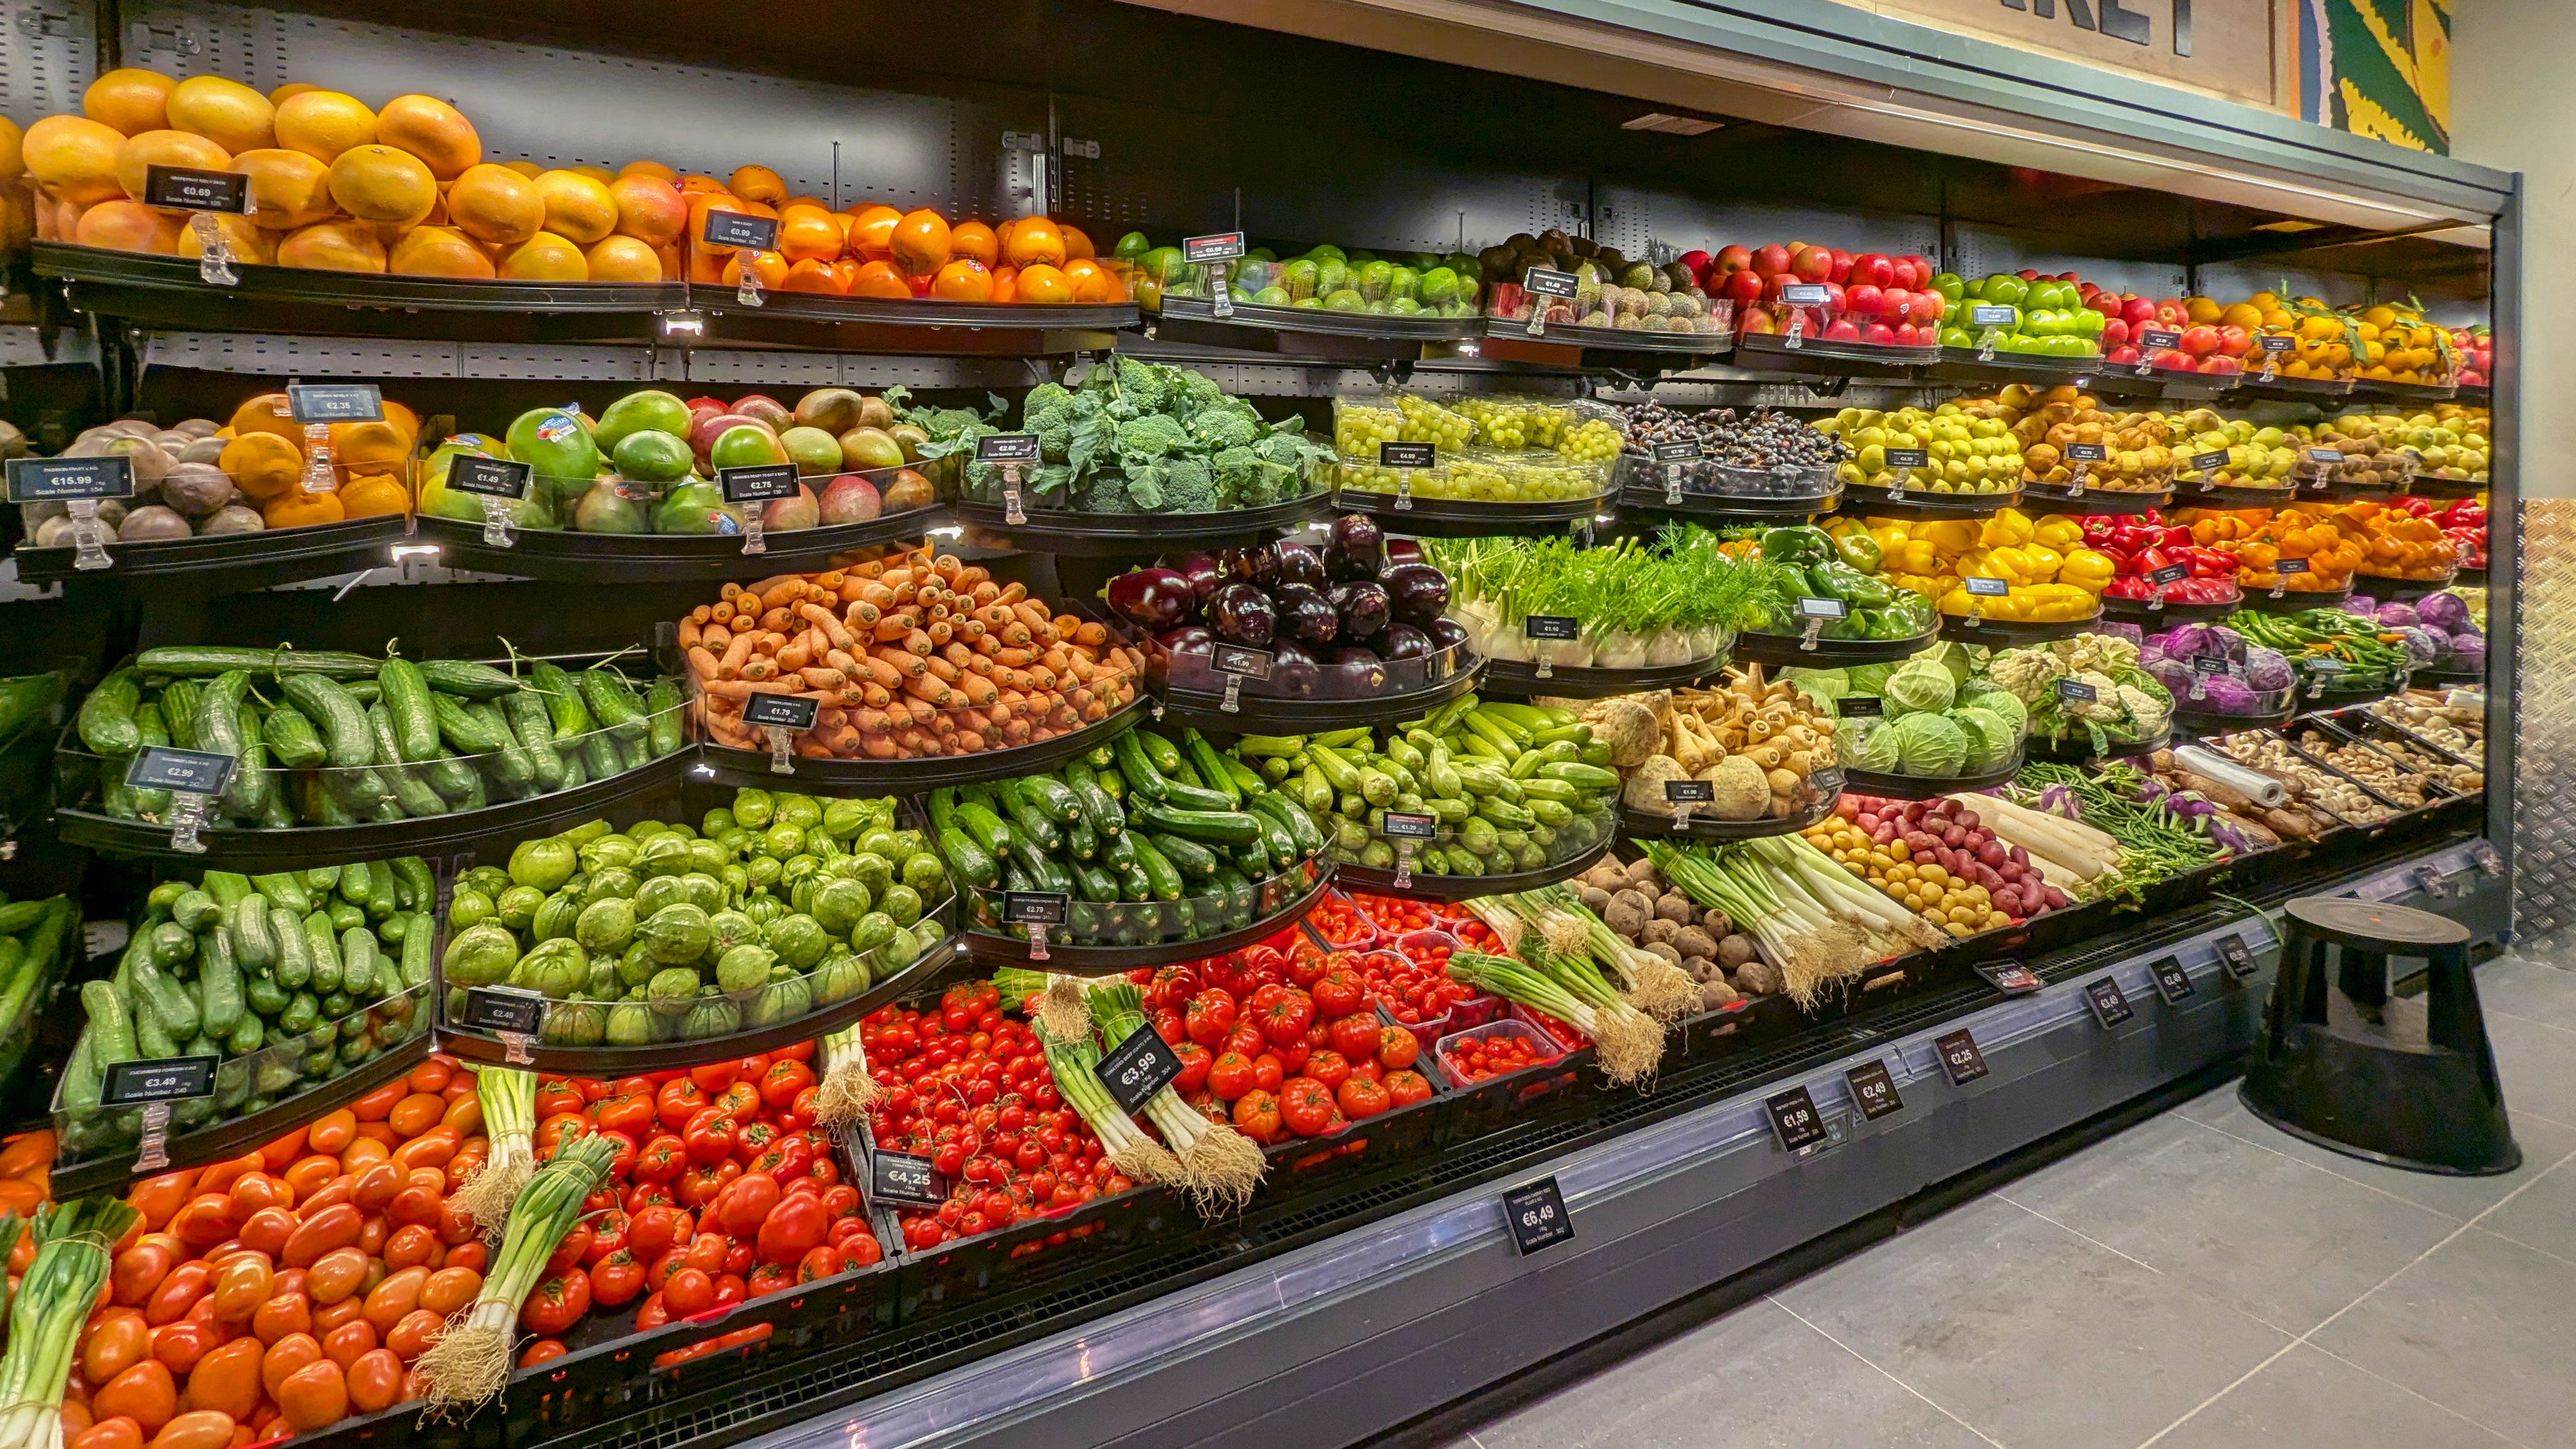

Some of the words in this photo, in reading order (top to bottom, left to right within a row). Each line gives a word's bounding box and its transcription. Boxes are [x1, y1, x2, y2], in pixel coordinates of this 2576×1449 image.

[183, 187, 211, 197] €0.69
[730, 227, 750, 237] €0.99
[538, 418, 556, 429] READY
[51, 476, 92, 486] €15.99
[477, 473, 499, 483] €1.49
[771, 707, 790, 716] €1.79
[167, 767, 194, 778] €2.99
[493, 1009, 514, 1019] €2.49
[1951, 1049, 1972, 1065] €2,25
[1121, 1052, 1156, 1085] €3,99
[146, 1077, 177, 1088] €3.49
[1862, 1081, 1887, 1098] €2,49
[1129, 1091, 1144, 1104] Scale
[1783, 1109, 1809, 1128] €1,59
[888, 1170, 931, 1186] €4,25
[1522, 1204, 1554, 1227] €6,49
